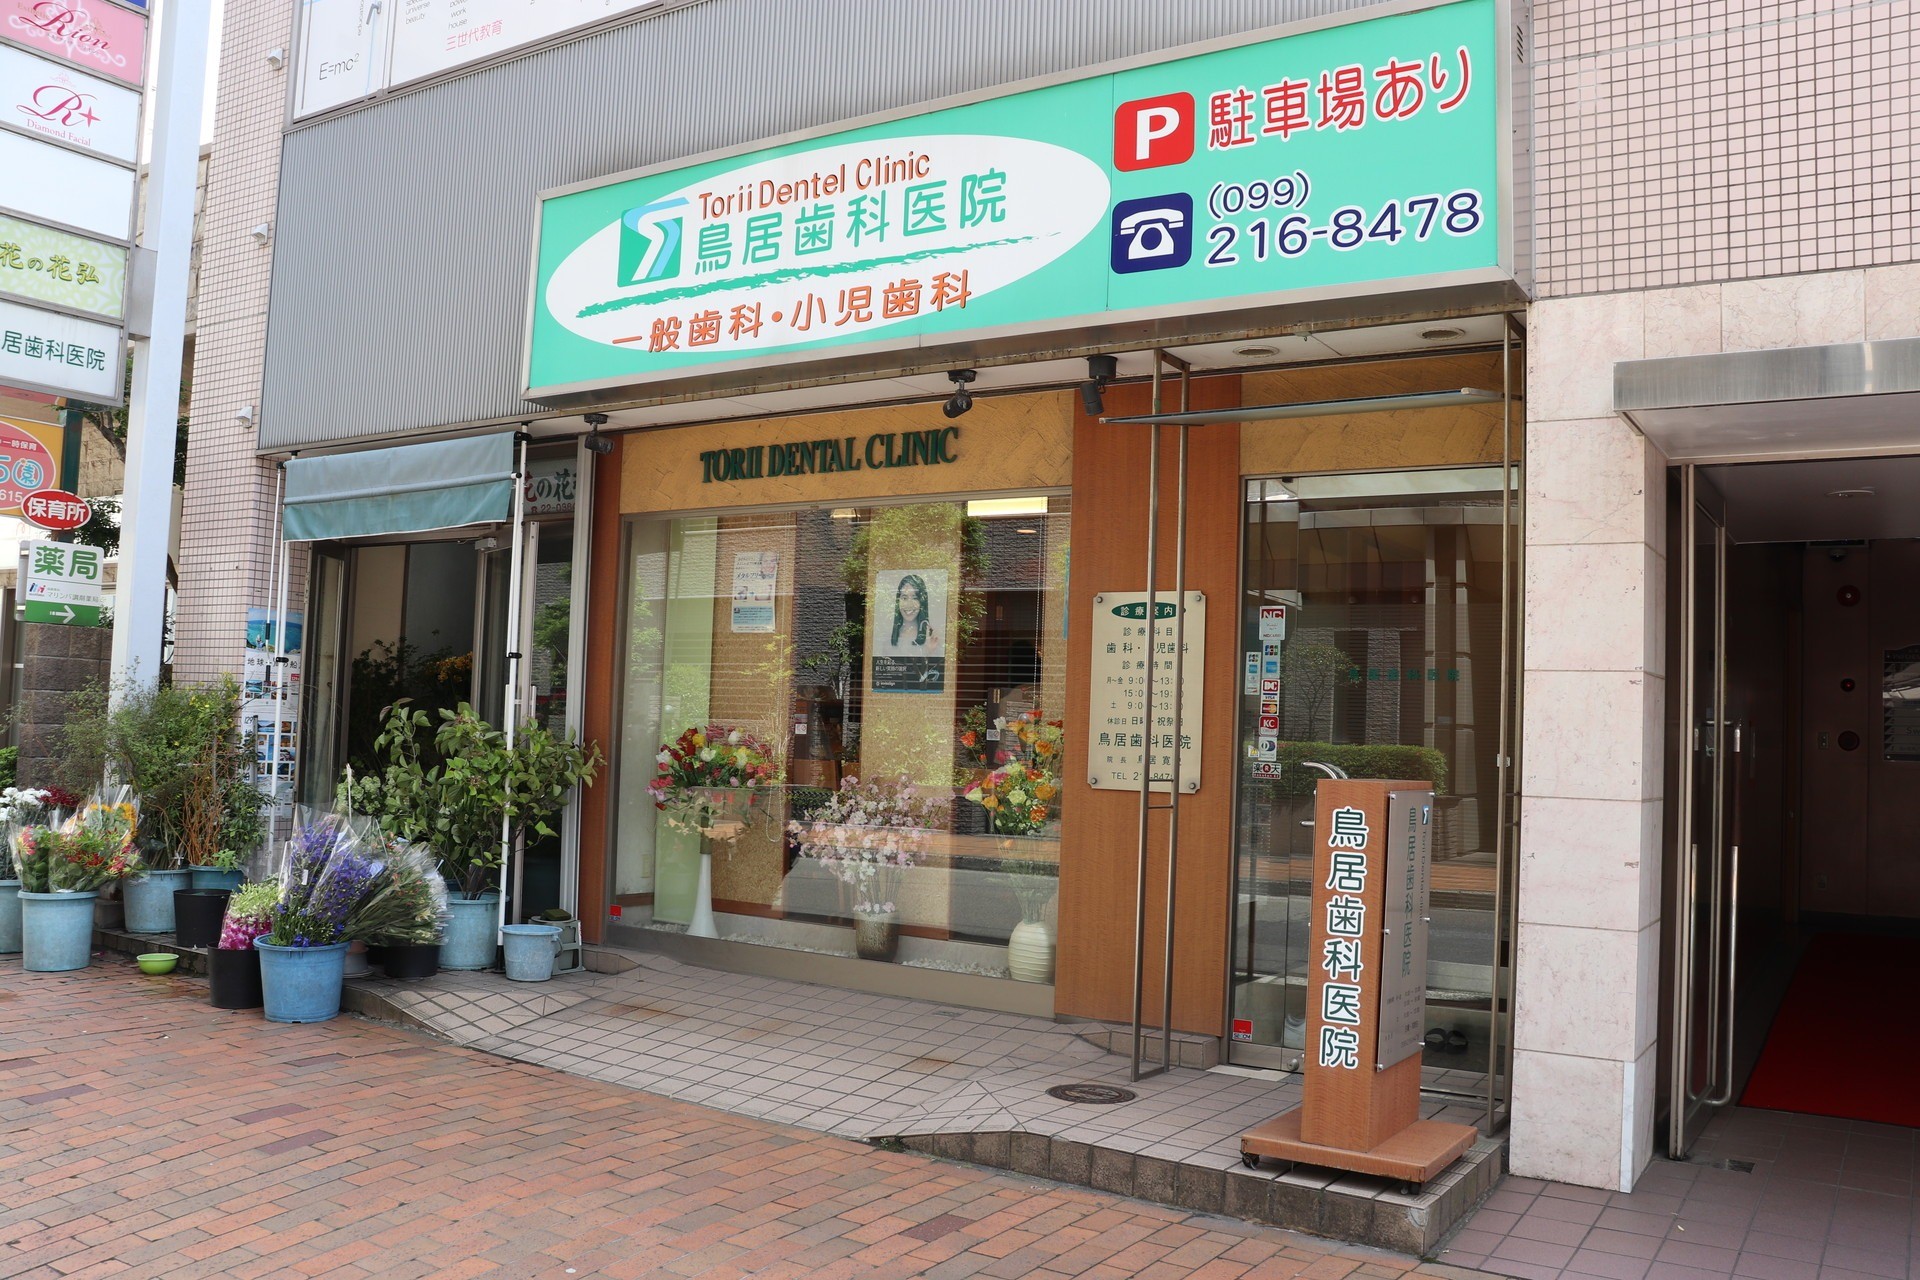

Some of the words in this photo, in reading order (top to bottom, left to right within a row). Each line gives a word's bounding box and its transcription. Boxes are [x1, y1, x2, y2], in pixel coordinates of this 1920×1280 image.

[405, 1, 431, 15] universe
[405, 13, 426, 25] beauty
[449, 18, 468, 29] house
[450, 7, 467, 18] work
[445, 19, 504, 51] 三世代教育
[1208, 48, 1471, 149] 駐車場あり
[27, 118, 66, 140] Diamond
[68, 132, 91, 147] Facial
[1135, 105, 1181, 161] P
[698, 184, 753, 221] Torii
[759, 164, 846, 209] Dentel
[855, 151, 931, 190] Clinic
[1208, 172, 1310, 219] (099)
[694, 168, 1007, 276] 鳥居歯科医院
[1207, 193, 1481, 265] 216-8478
[612, 268, 972, 354] 一般歯科・小児歯科
[1, 330, 106, 371] 居歯科医院
[699, 445, 764, 483] TORII
[766, 436, 861, 477] DENTAL
[864, 426, 959, 470] CLINIC
[27, 496, 86, 522] 保育所
[34, 545, 99, 580] 薬局
[1106, 642, 1189, 654] 歯科・児歯科
[1263, 719, 1275, 728] KC
[1098, 732, 1191, 749] 鳥居歯科医院
[1112, 772, 1127, 780] TEL
[1320, 808, 1368, 1068] 鳥居歯科医院
